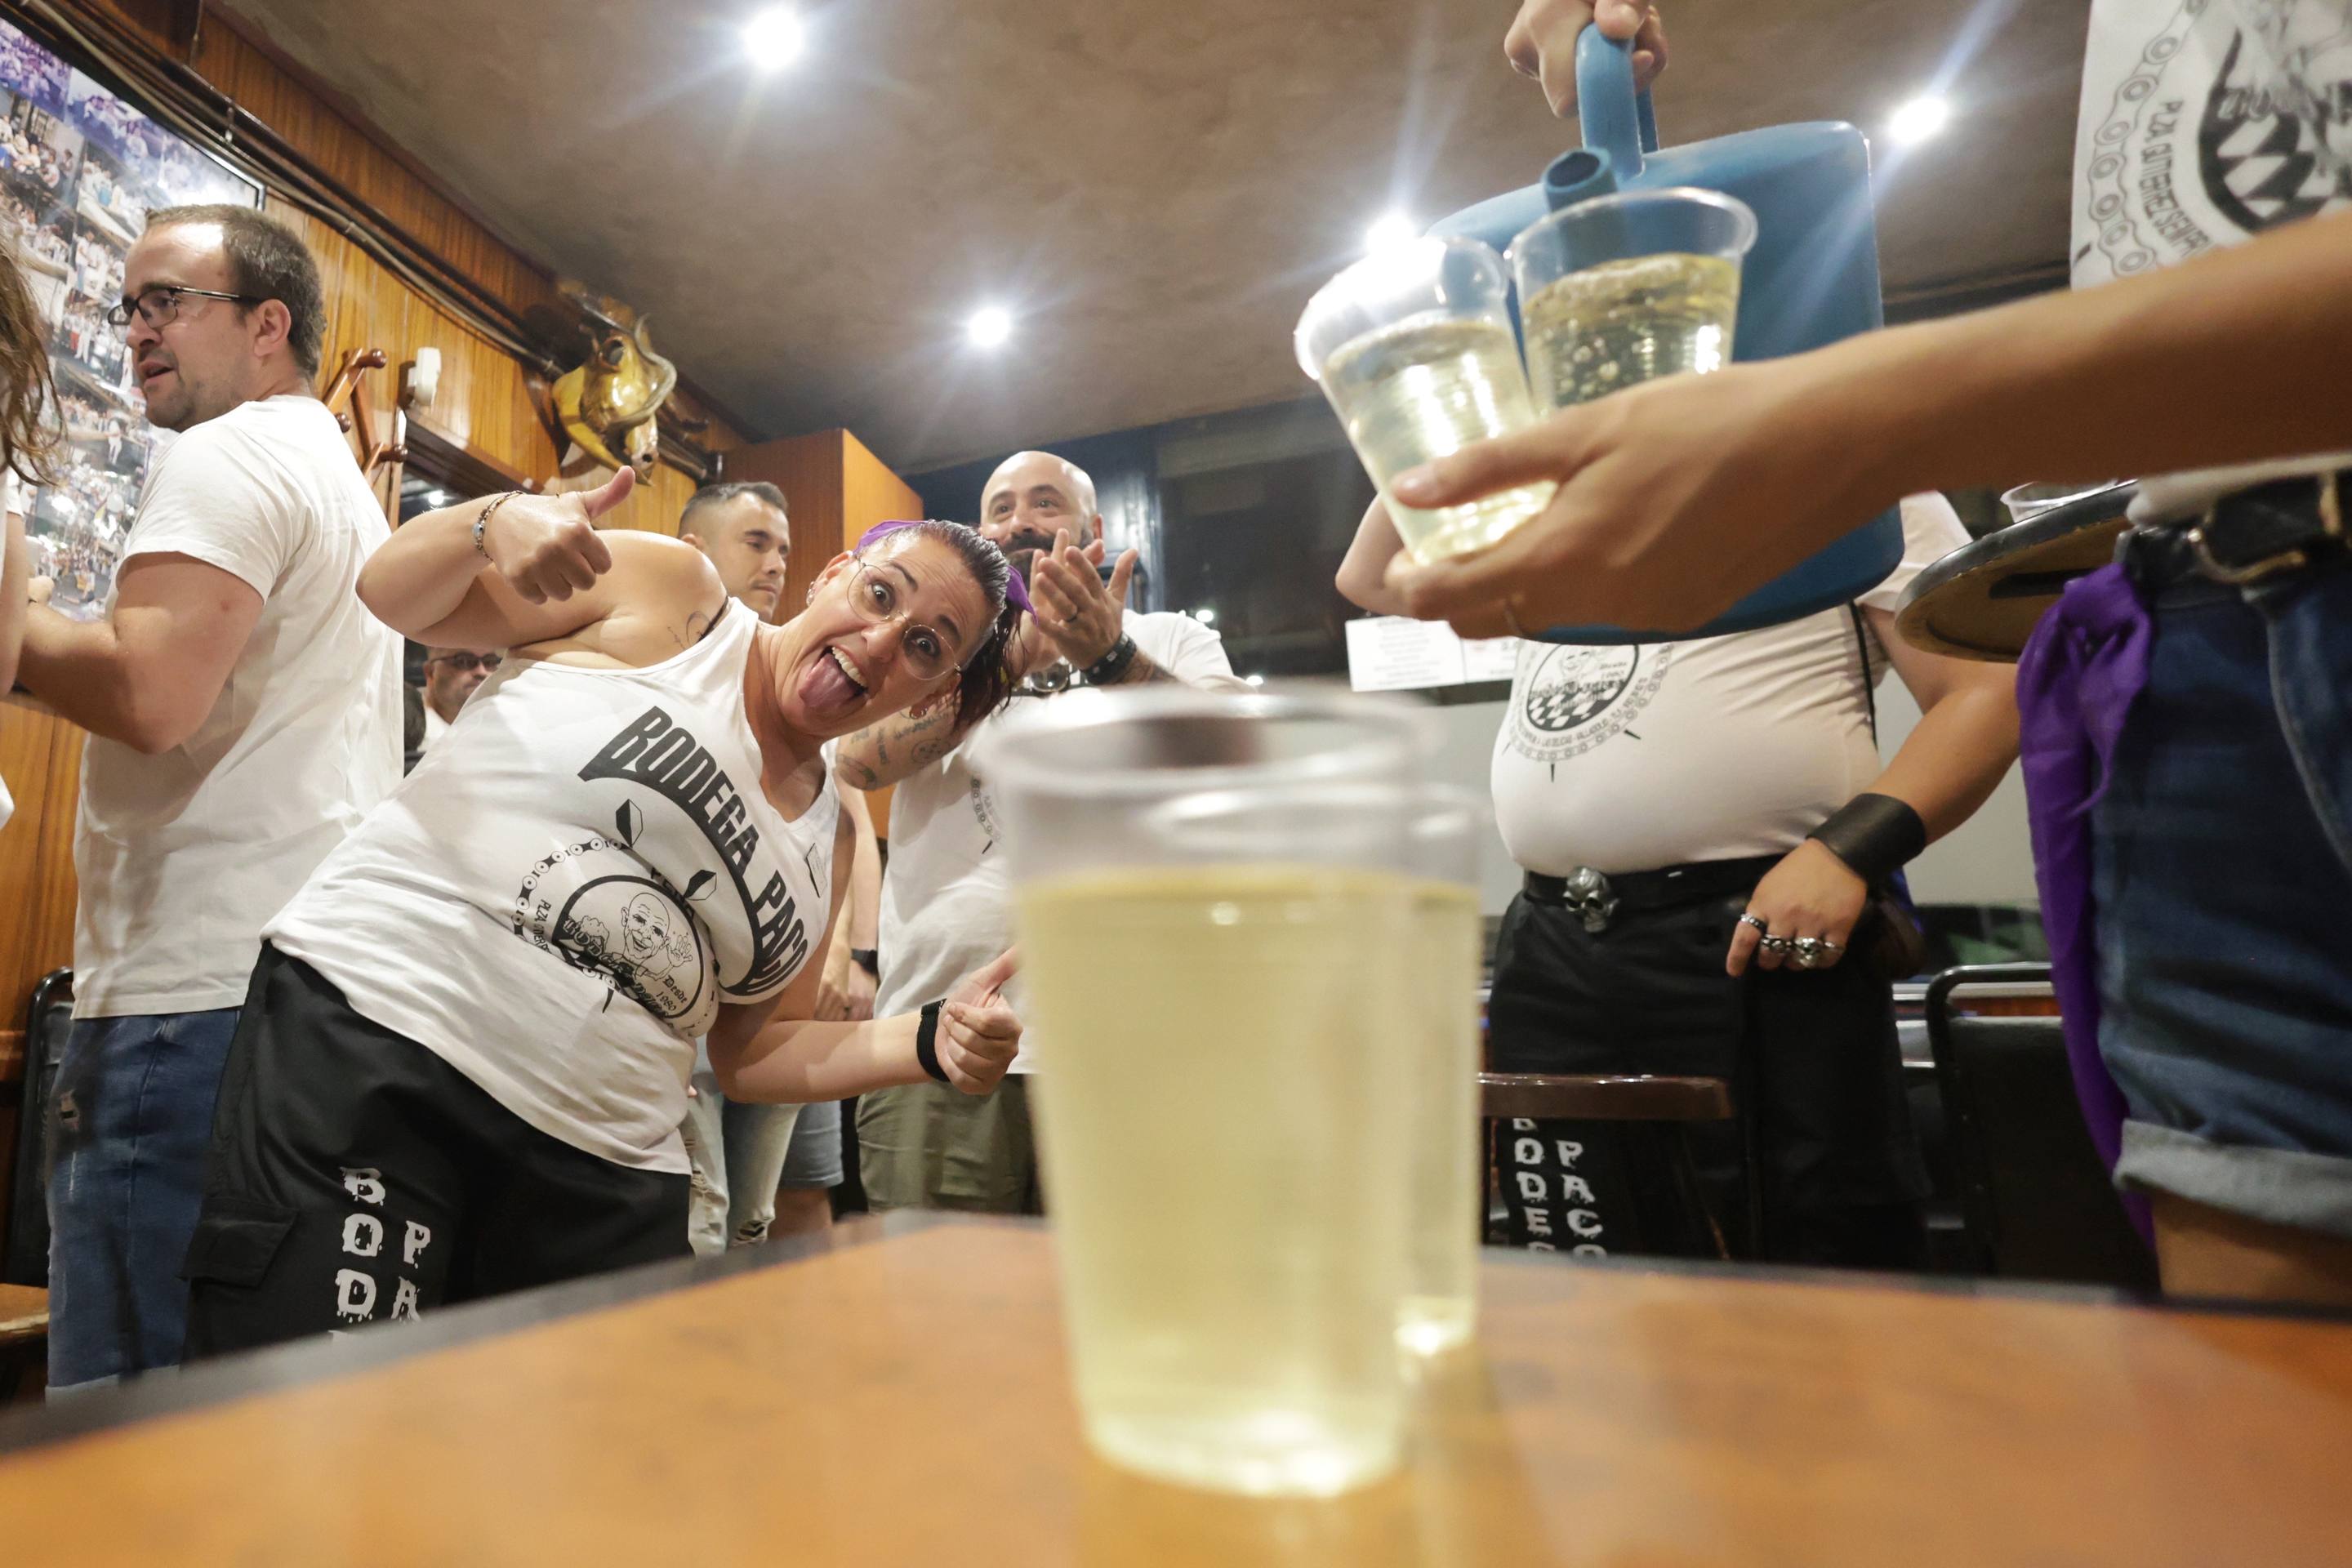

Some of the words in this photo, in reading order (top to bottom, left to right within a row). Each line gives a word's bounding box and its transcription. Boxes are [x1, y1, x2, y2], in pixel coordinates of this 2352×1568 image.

[577, 706, 760, 878] BODEGA
[735, 869, 808, 996] PACO
[328, 1166, 386, 1343] BOD
